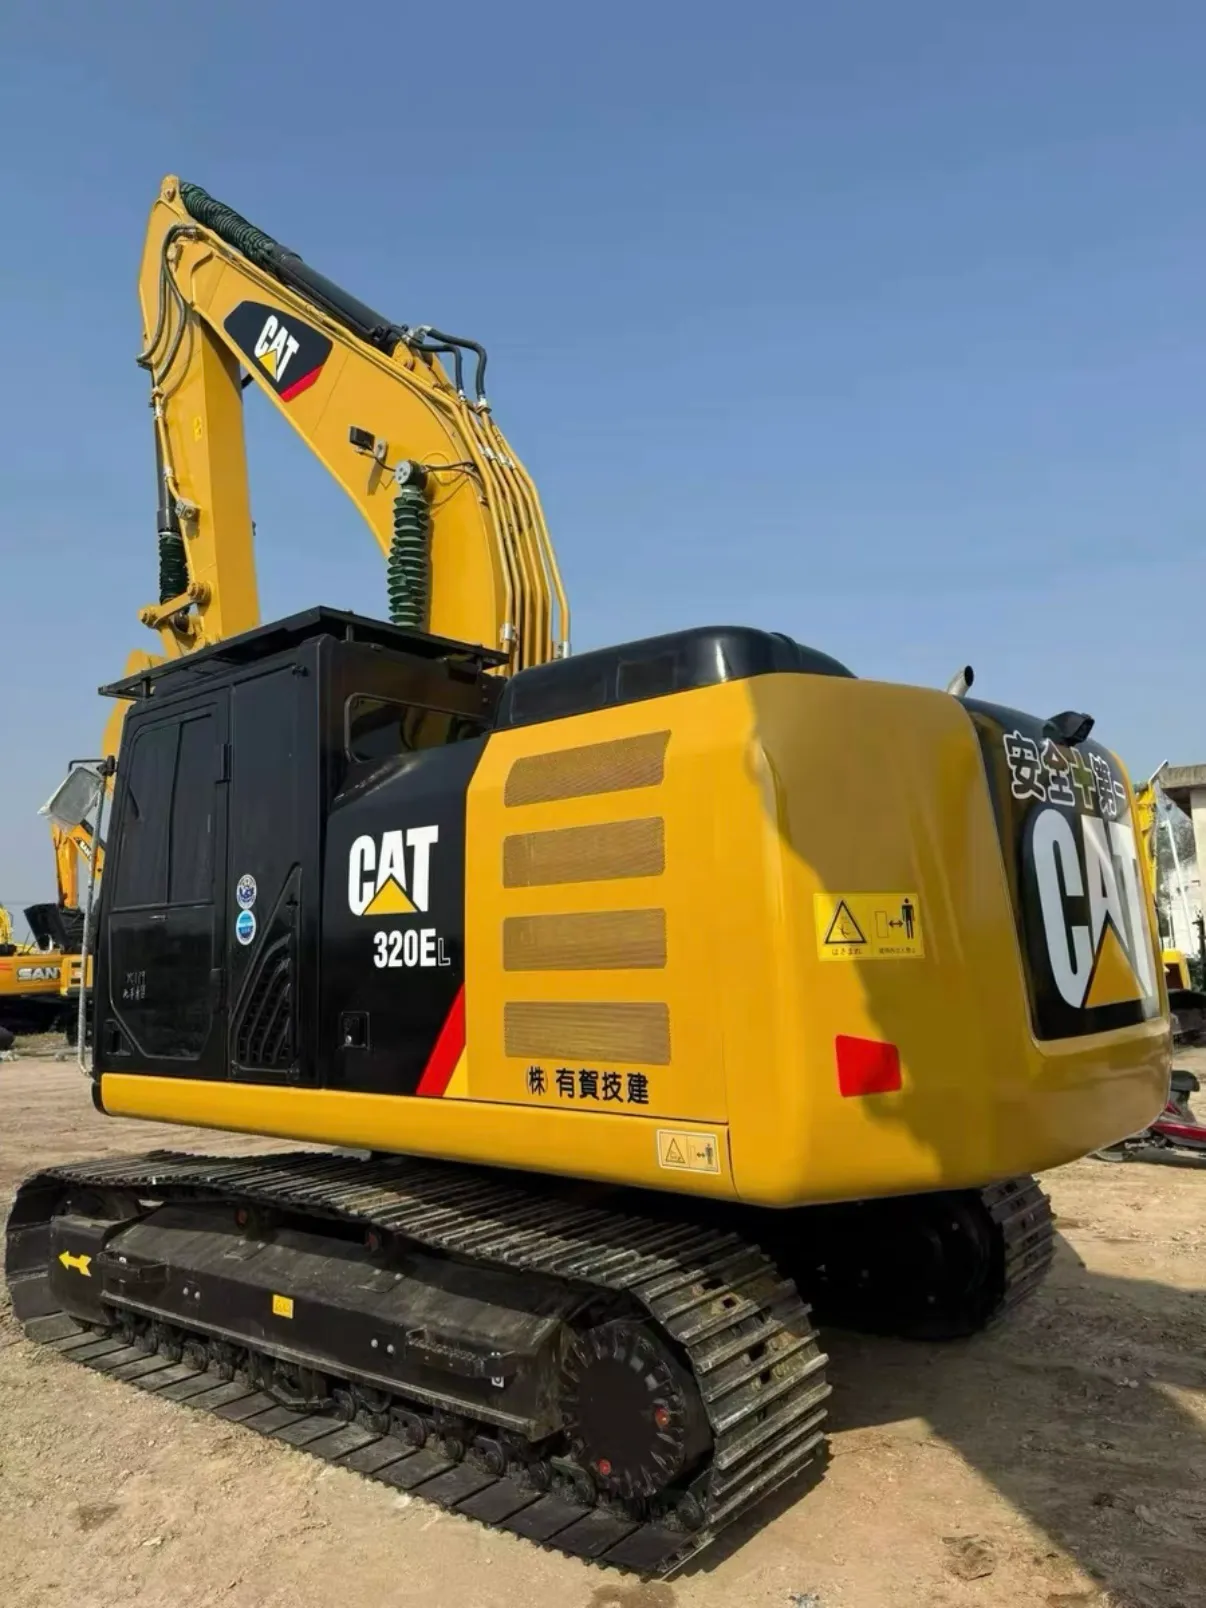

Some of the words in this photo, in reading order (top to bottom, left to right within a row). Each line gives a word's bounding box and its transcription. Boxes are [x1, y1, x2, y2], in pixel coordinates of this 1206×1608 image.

[254, 314, 300, 382] CAT
[348, 824, 439, 916] CAT
[1032, 808, 1152, 1009] CAT
[17, 967, 62, 981] SAN
[555, 1067, 649, 1104] 有賀技建
